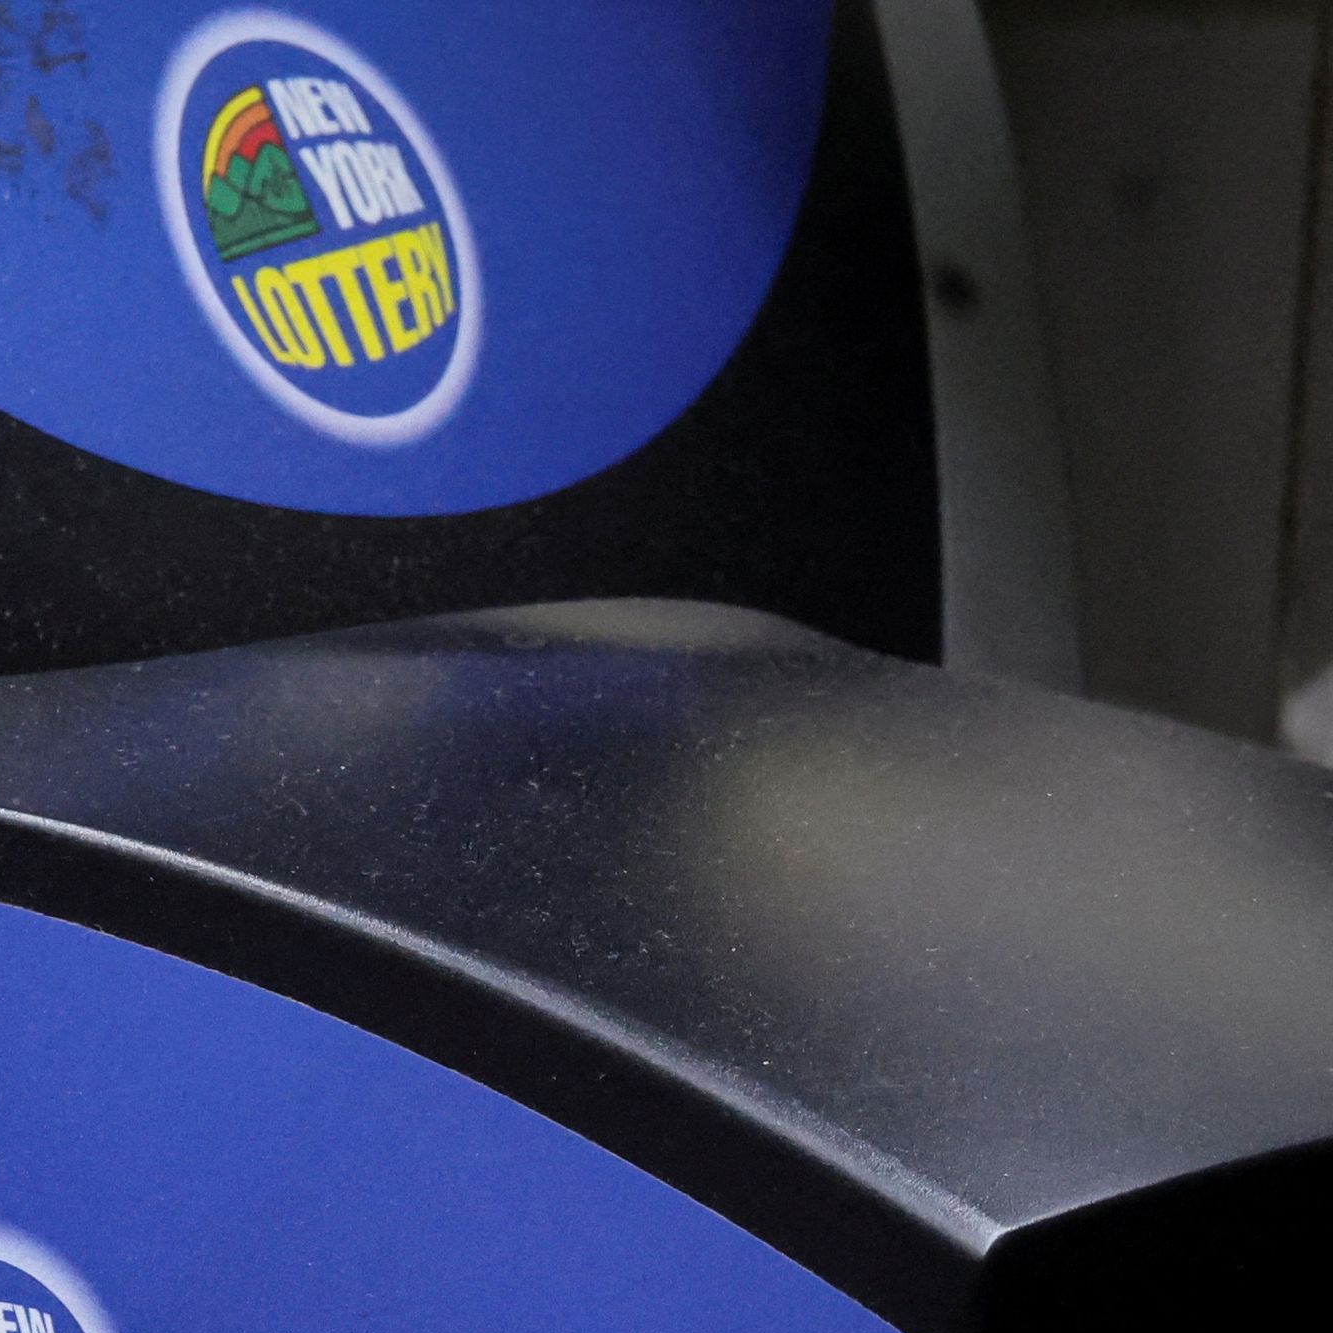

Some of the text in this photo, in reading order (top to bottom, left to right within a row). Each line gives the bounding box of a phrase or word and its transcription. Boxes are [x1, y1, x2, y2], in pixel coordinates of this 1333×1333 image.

[266, 77, 372, 140] NEW
[298, 139, 425, 229] YORK
[231, 222, 454, 369] LOTTERY
